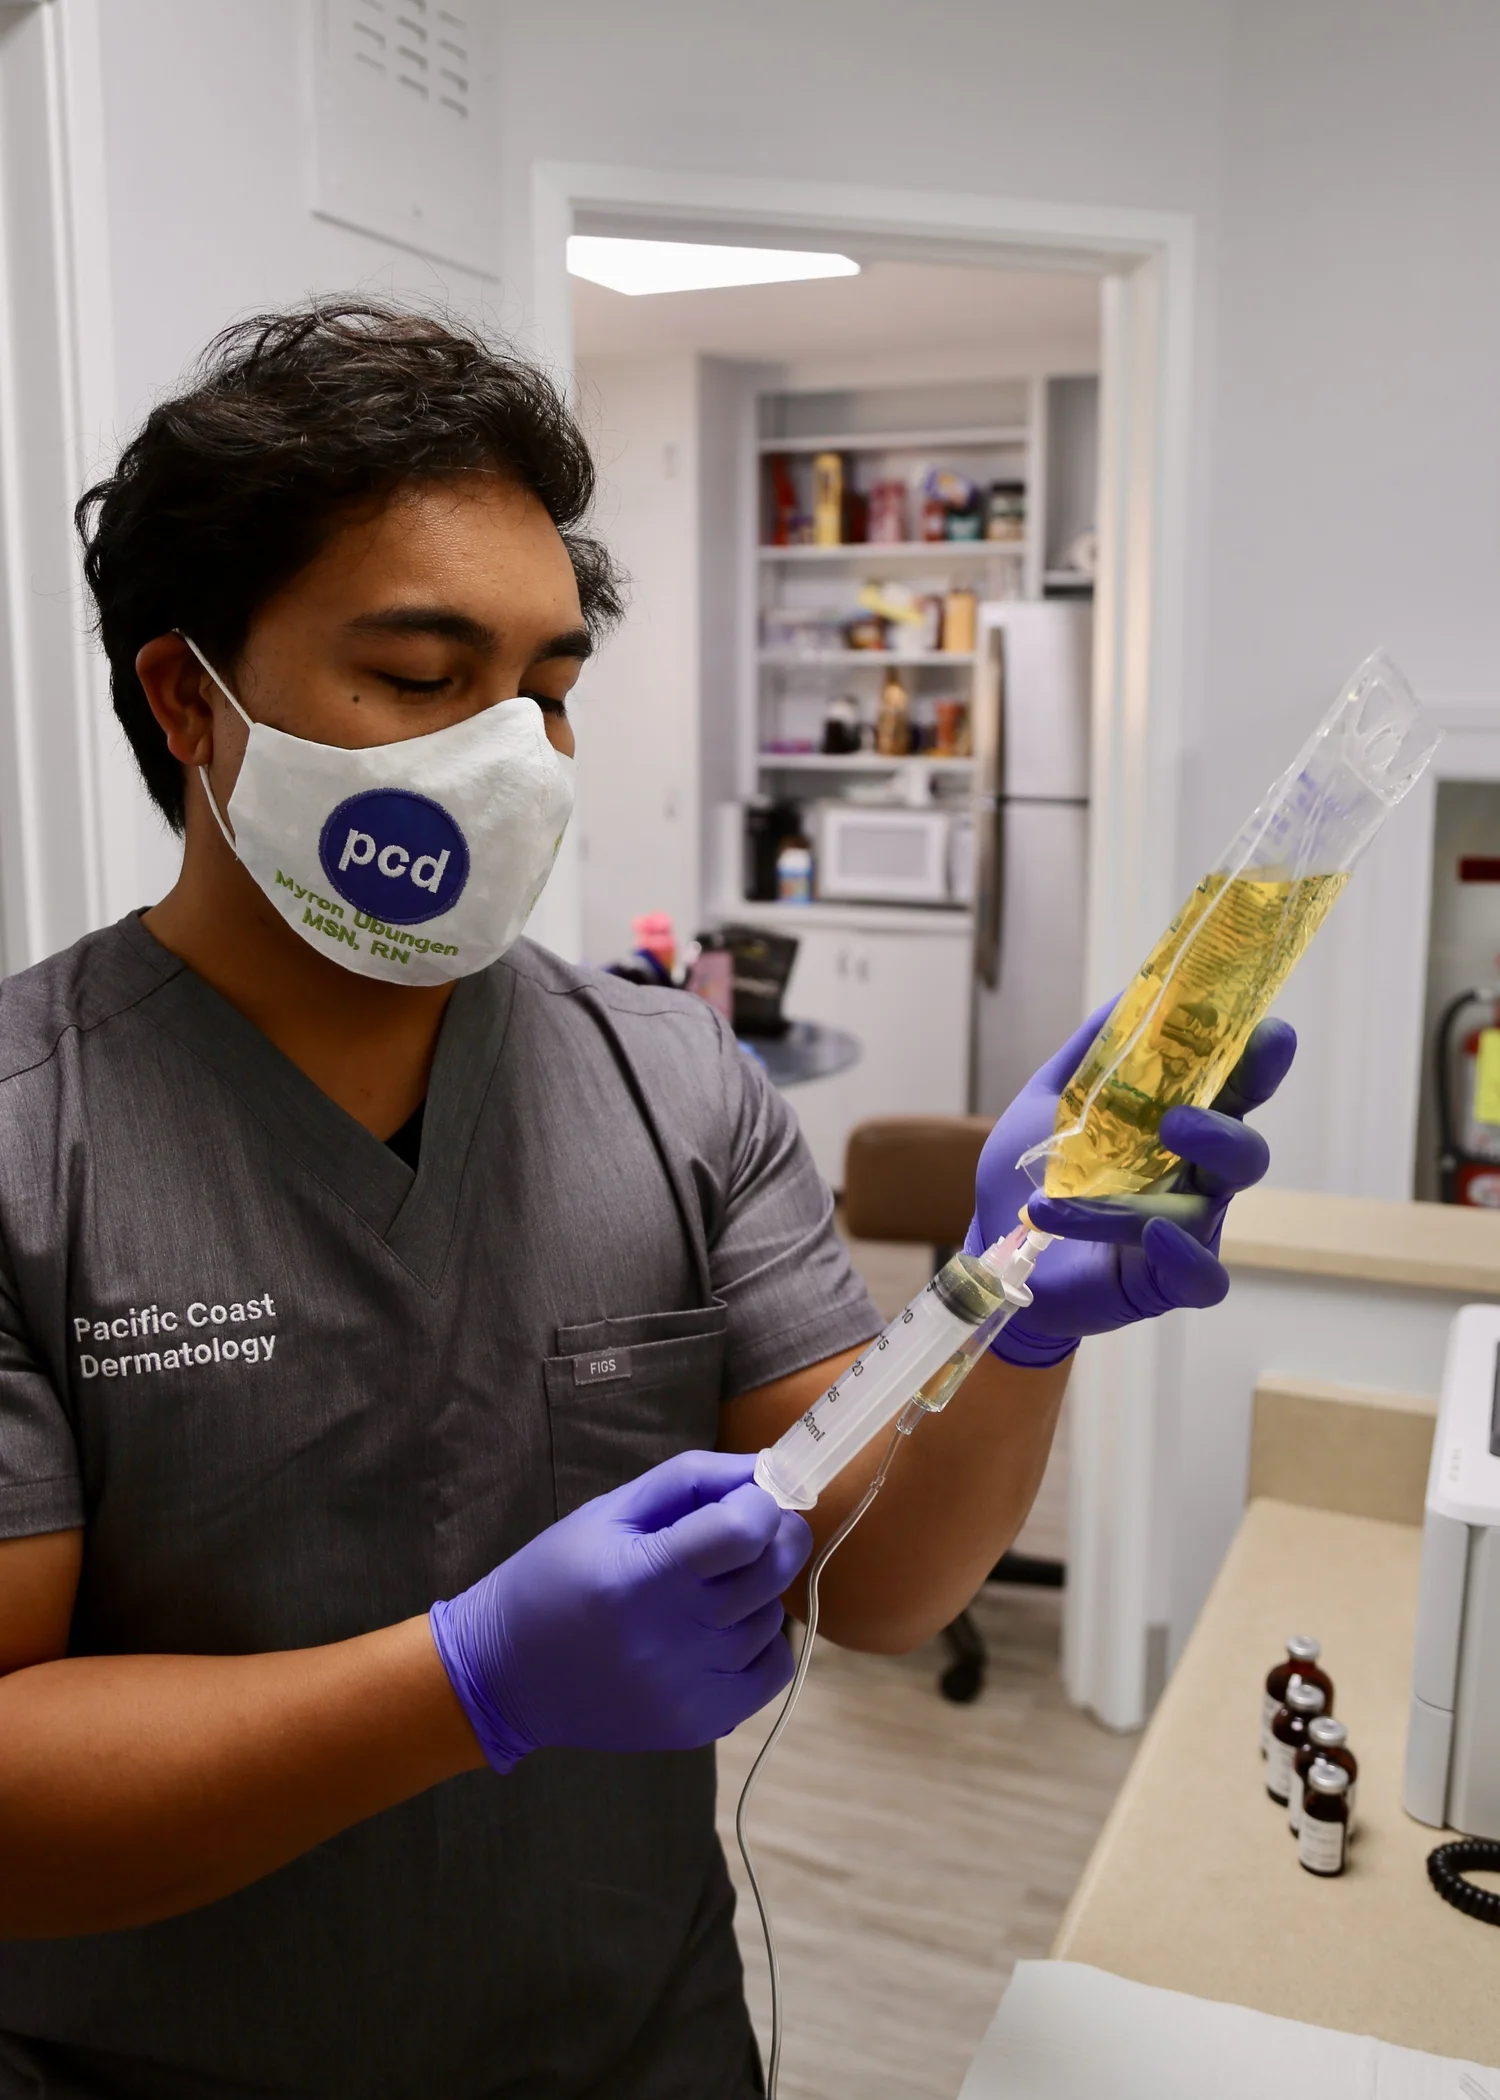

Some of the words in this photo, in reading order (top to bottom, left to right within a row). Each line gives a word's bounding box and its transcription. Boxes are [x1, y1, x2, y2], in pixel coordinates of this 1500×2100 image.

[338, 828, 451, 894] pcd
[275, 867, 345, 919] Myron
[353, 910, 459, 957] Ubungen
[302, 905, 360, 951] MSN,
[370, 940, 411, 965] RN
[73, 1304, 179, 1342] Pacific
[187, 1293, 277, 1328] Coast
[901, 1307, 914, 1325] 10
[80, 1335, 276, 1379] Dermatology
[876, 1335, 890, 1351] 15
[590, 1359, 616, 1375] FIGS
[851, 1360, 864, 1377] 20
[827, 1386, 840, 1403] 25
[803, 1411, 826, 1442] 30ml
